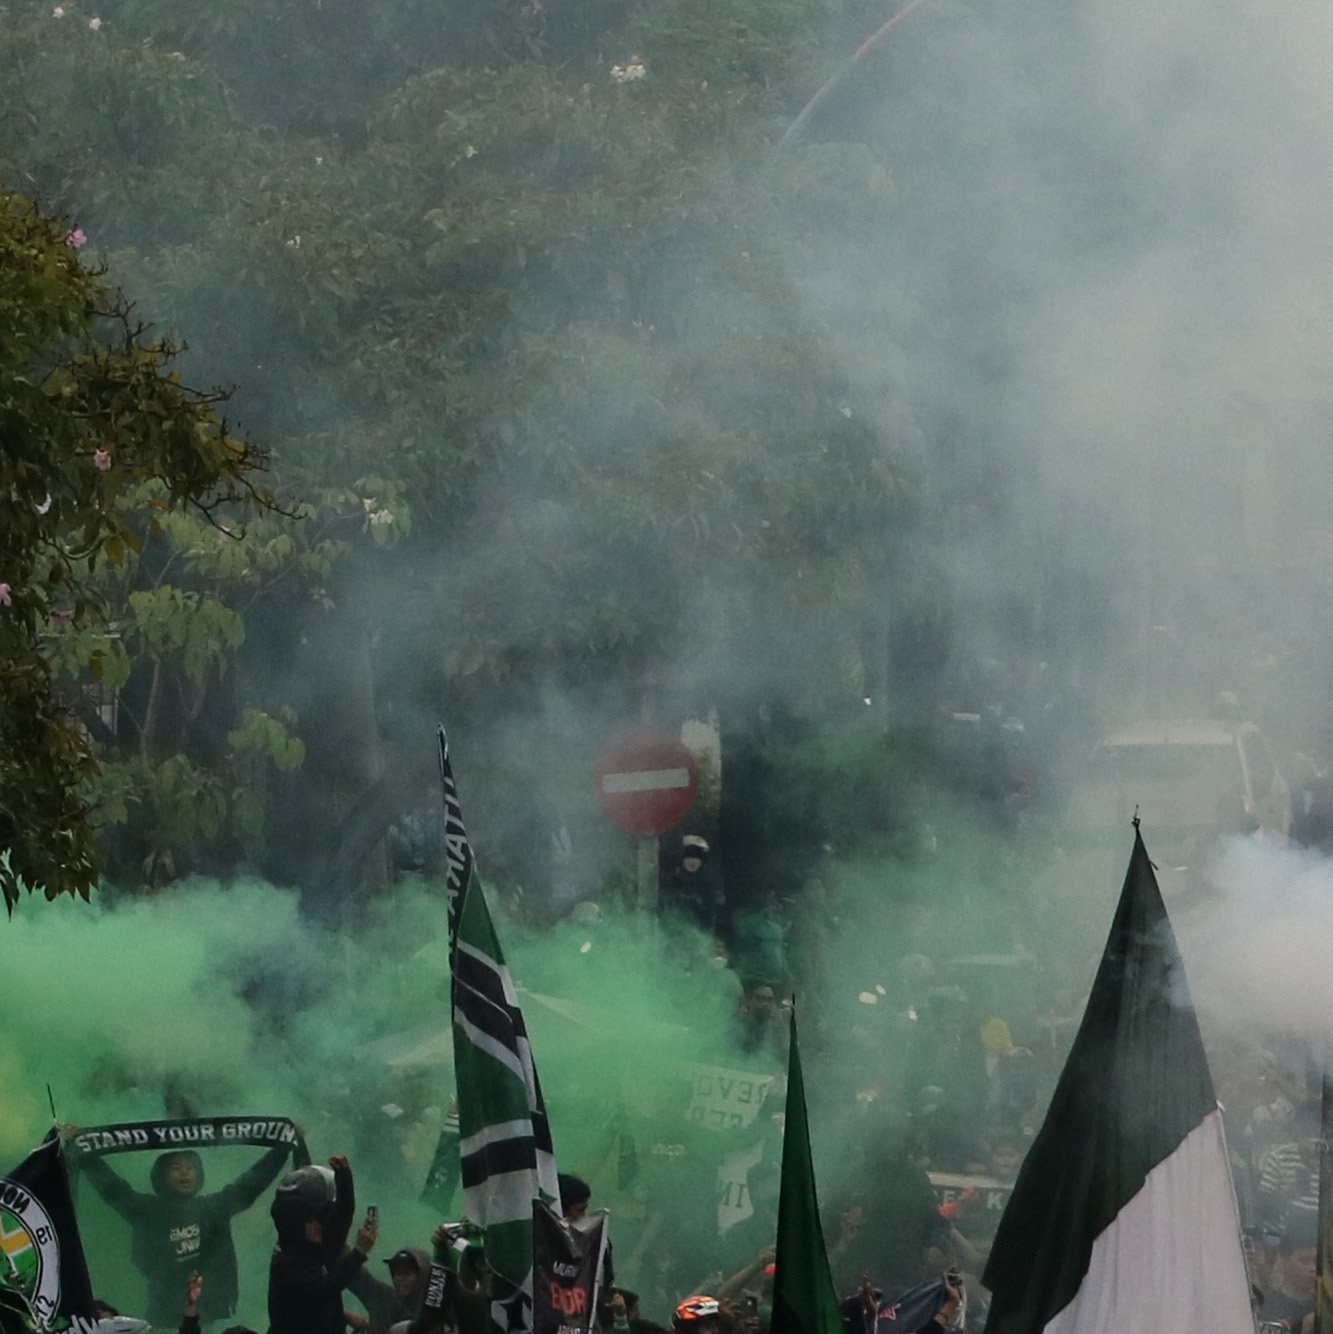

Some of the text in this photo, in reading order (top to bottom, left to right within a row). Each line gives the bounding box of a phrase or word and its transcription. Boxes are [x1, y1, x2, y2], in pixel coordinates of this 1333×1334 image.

[76, 1121, 299, 1152] STAND YOUR GROUN
